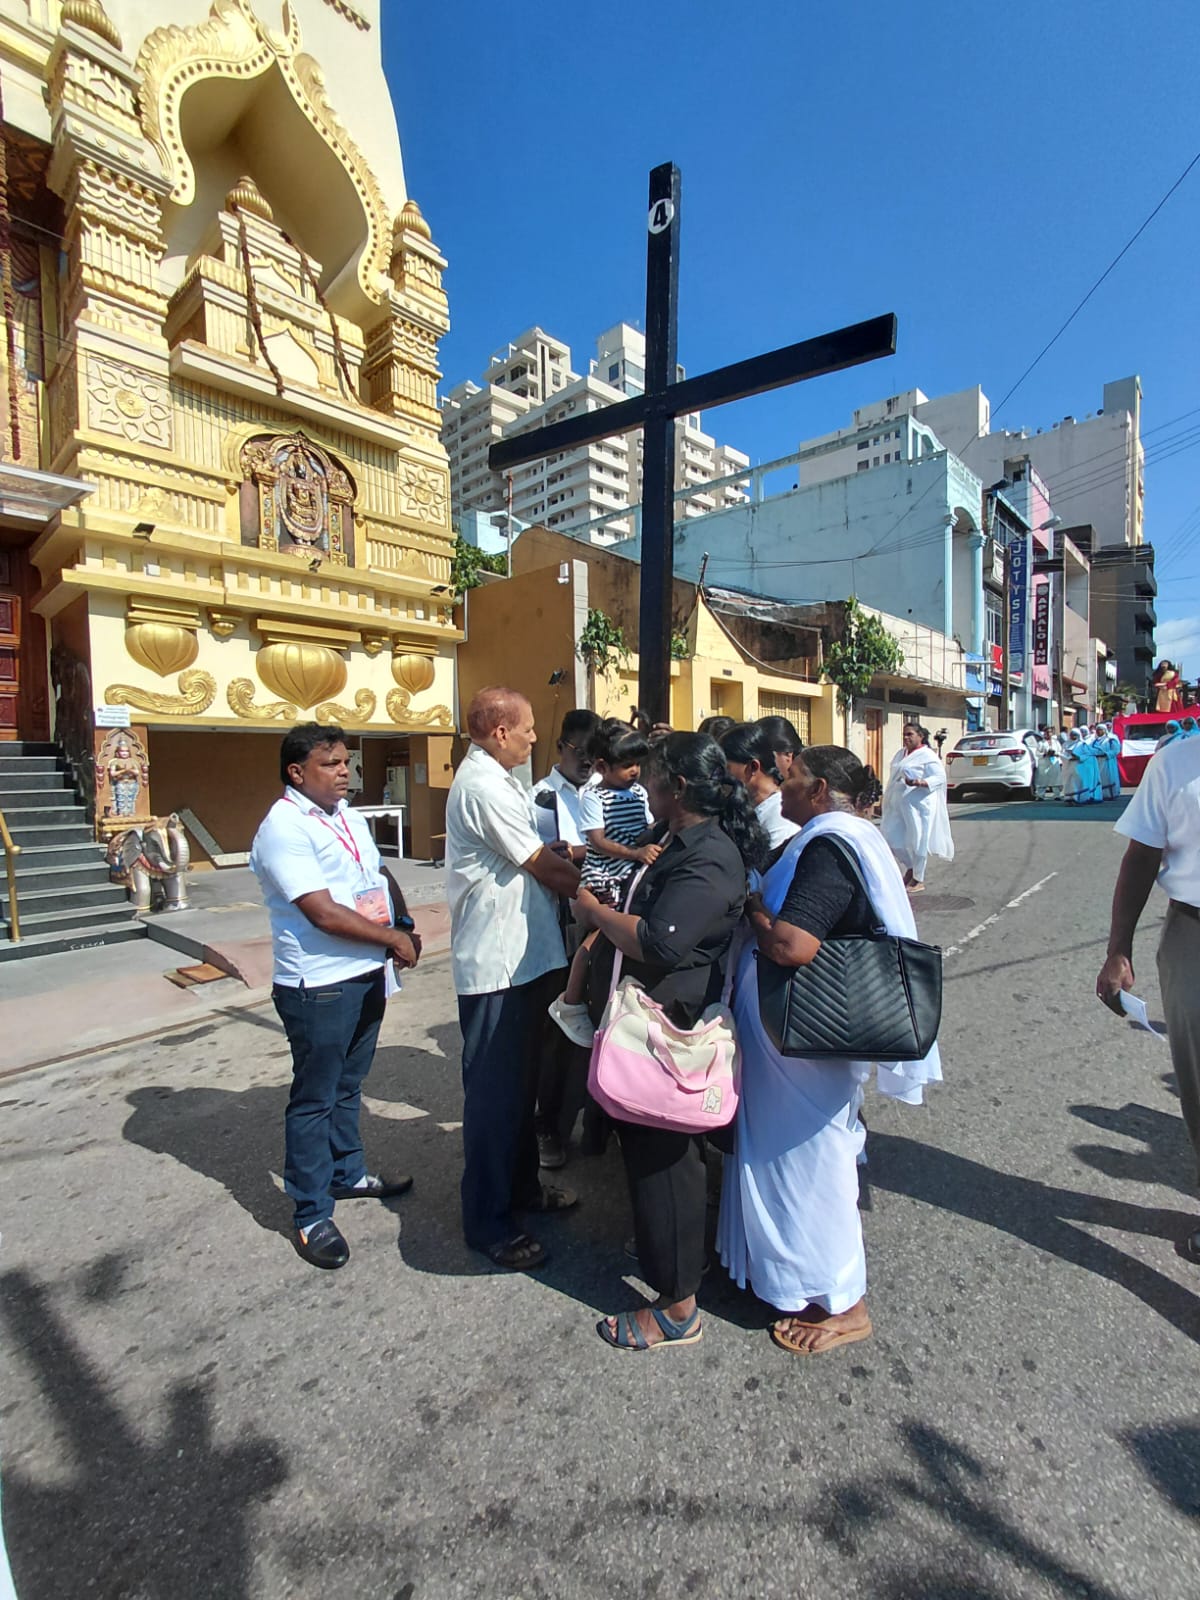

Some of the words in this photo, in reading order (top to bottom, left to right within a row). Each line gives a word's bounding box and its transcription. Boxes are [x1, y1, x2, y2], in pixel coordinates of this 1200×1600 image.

[653, 201, 668, 227] 4
[1011, 543, 1021, 624] JOTYSS
[1036, 597, 1047, 639] APPALO
[1036, 642, 1046, 663] INN
